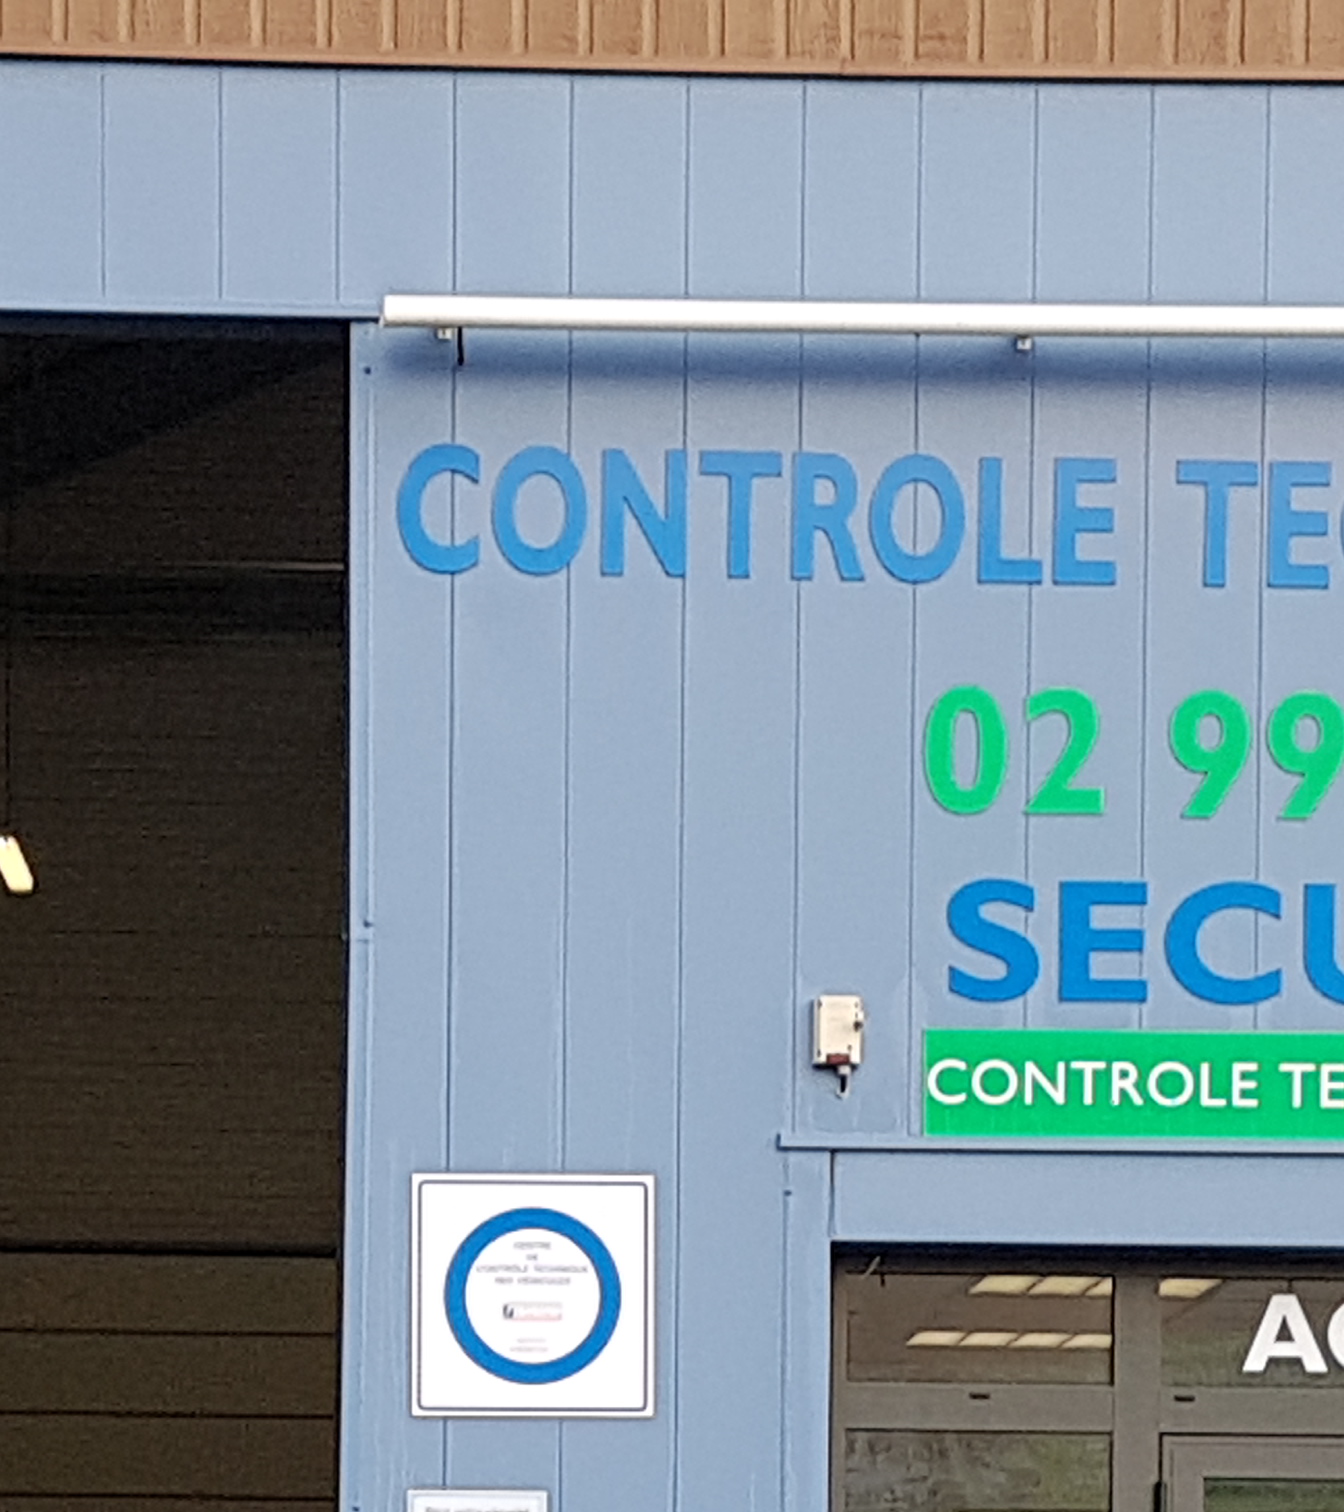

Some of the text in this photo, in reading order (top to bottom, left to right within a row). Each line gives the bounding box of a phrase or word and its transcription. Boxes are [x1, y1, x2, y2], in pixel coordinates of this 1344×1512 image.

[396, 443, 1117, 587] CONTROLE
[923, 685, 1106, 816] 02
[925, 1056, 1258, 1110] CONTROLE
